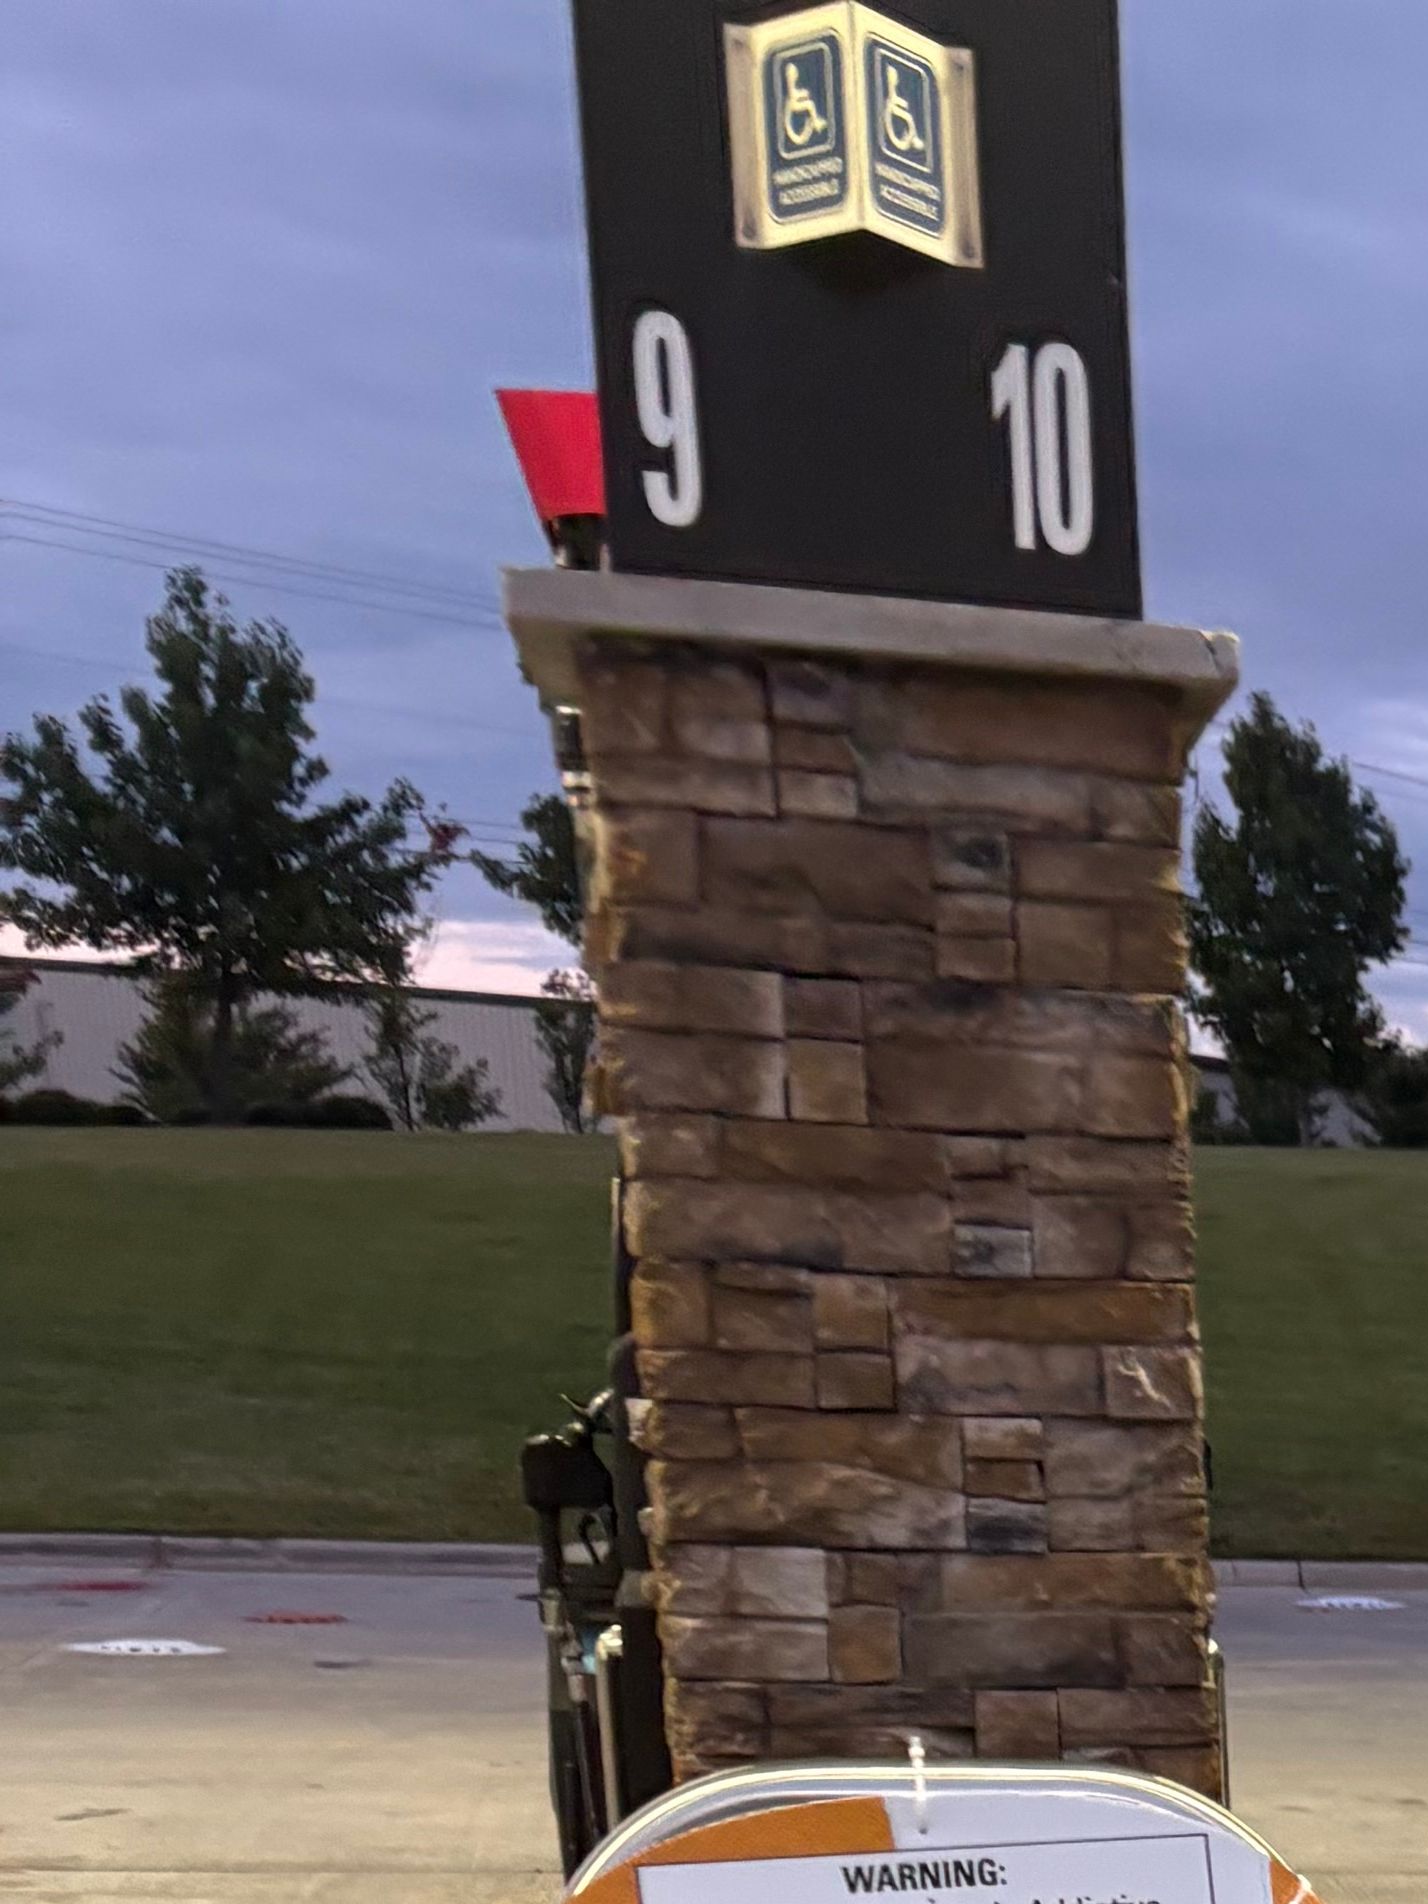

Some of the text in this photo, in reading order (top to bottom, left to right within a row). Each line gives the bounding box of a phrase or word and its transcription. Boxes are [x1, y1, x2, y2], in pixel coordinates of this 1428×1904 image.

[632, 309, 702, 527] 9
[991, 341, 1094, 556] 10
[840, 1858, 1008, 1894] WARNING:
